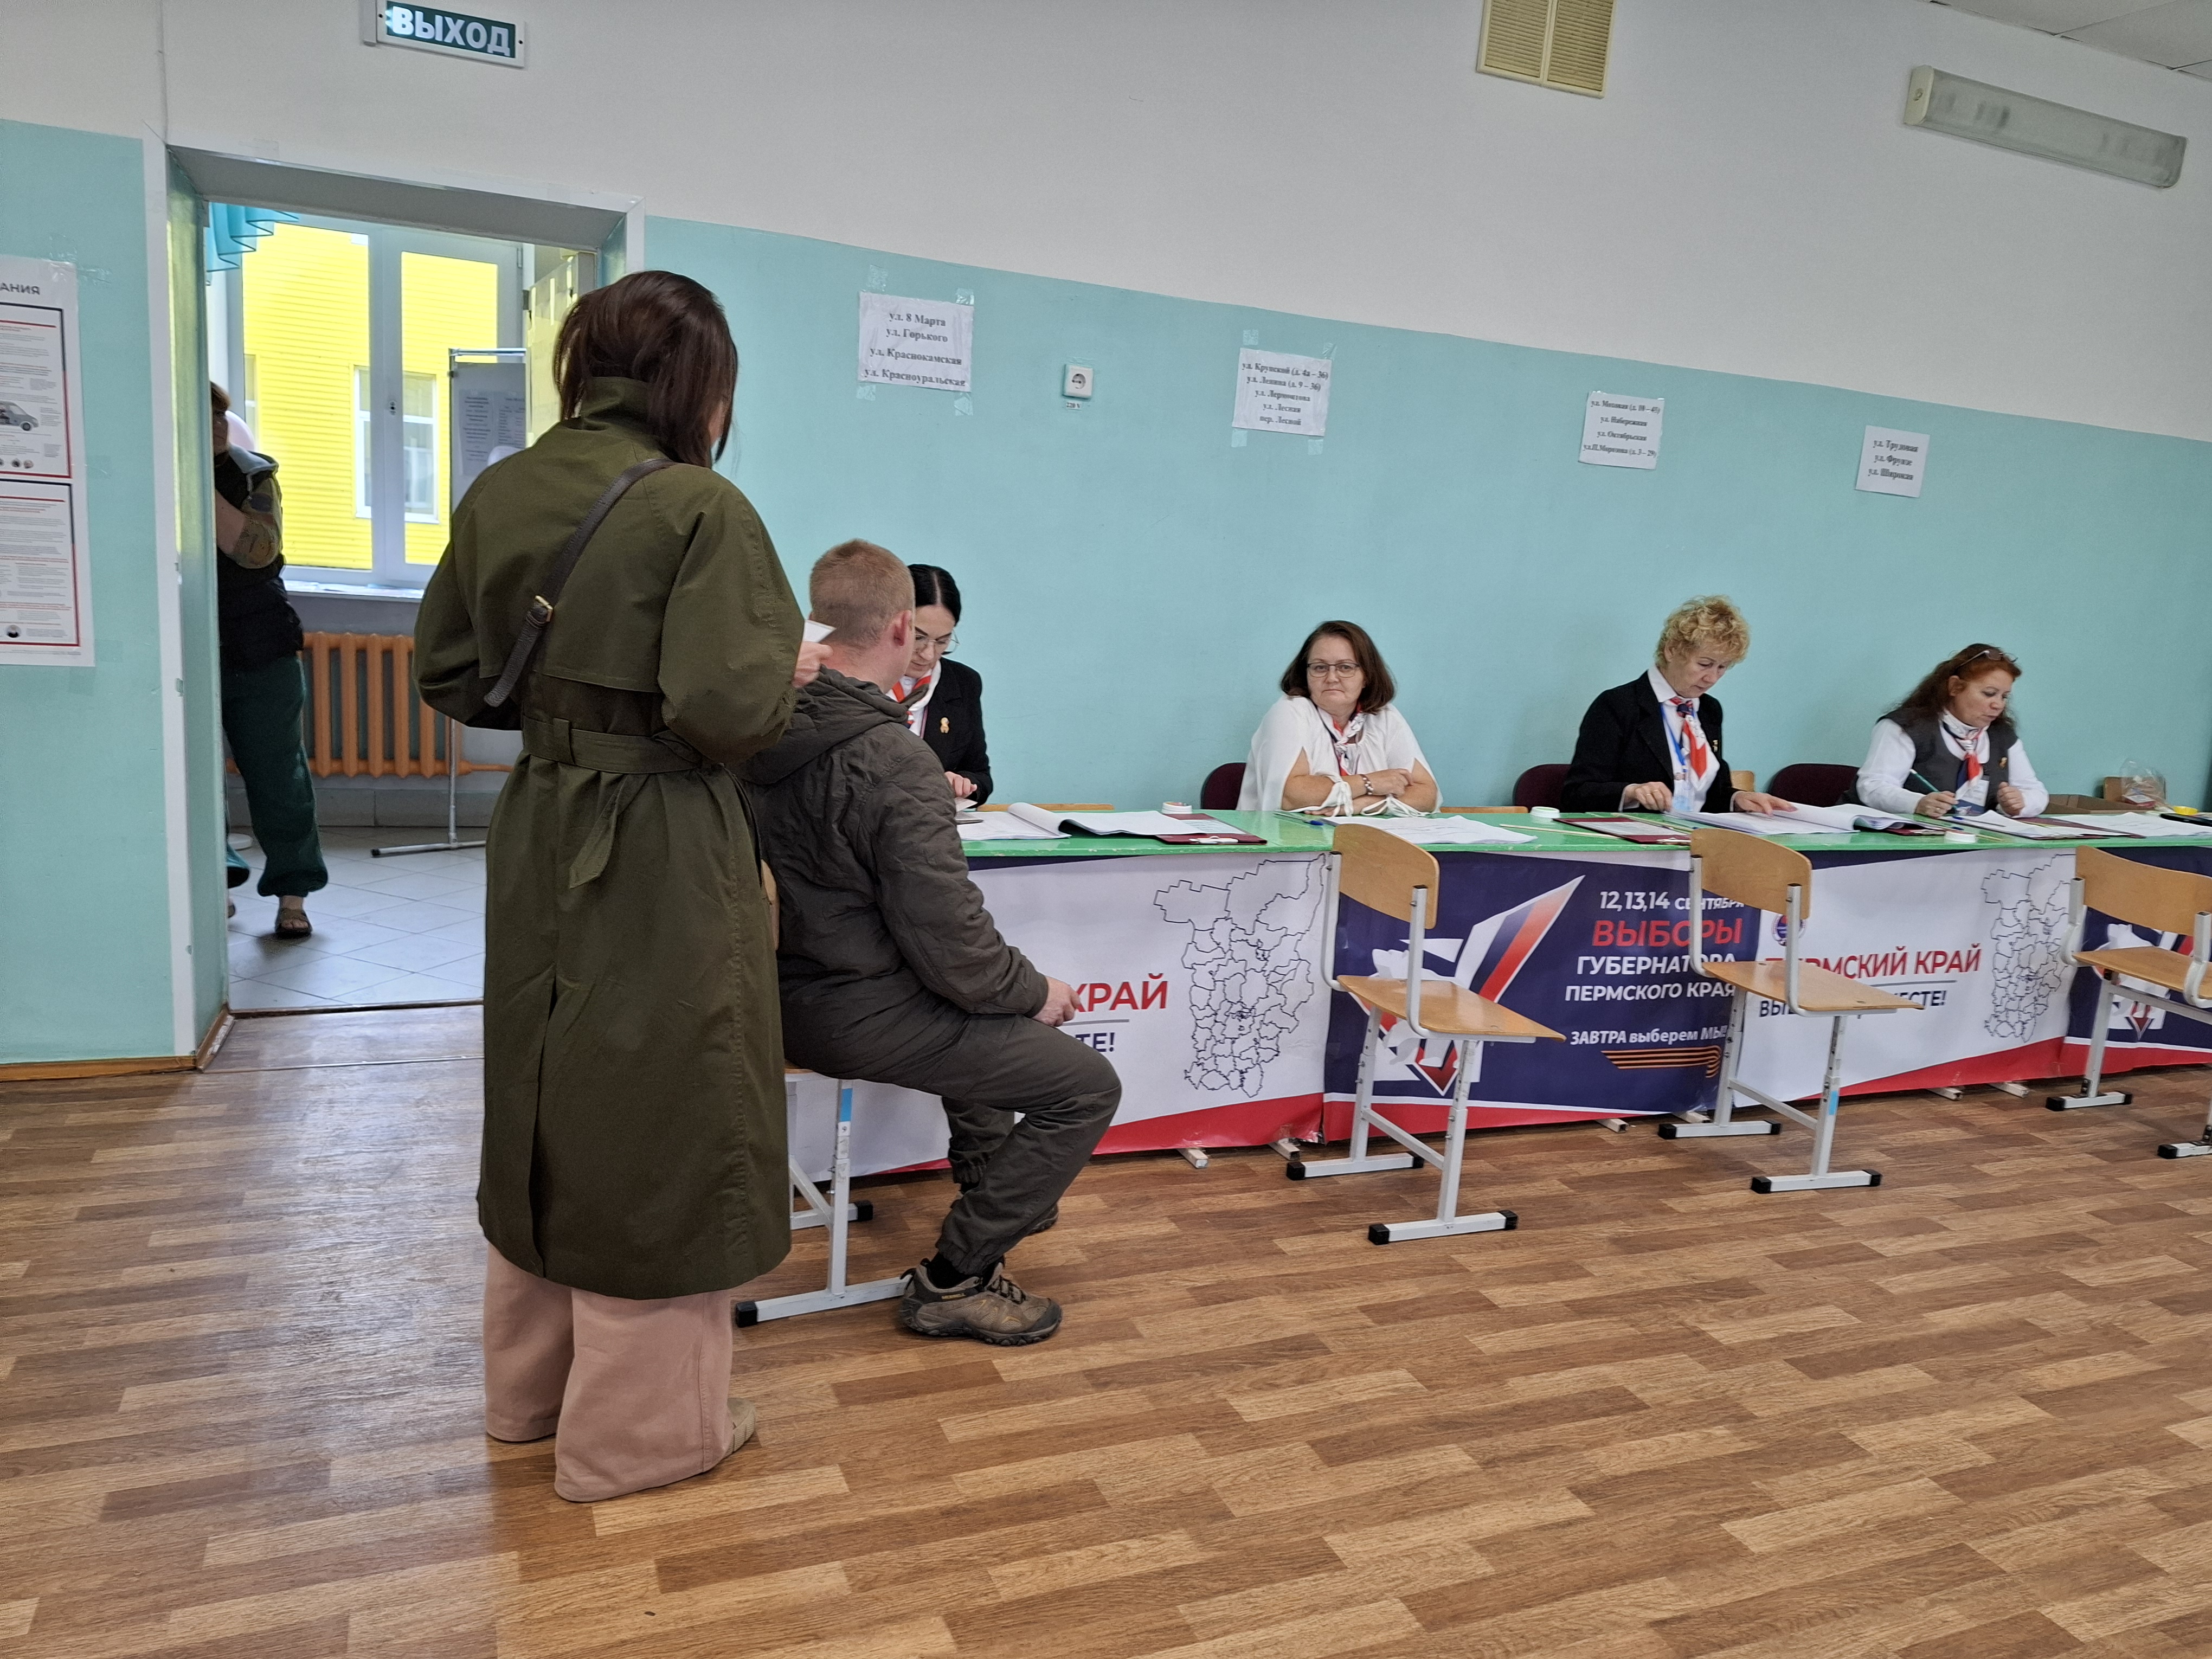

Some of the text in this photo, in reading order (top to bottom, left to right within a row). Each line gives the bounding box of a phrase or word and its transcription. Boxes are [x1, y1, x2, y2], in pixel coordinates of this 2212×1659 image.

[392, 6, 510, 57] ВЫХОД
[889, 313, 946, 327] ул. 8 Марта
[886, 329, 948, 343] ул. Горького
[870, 348, 962, 365] ул. Краснокамская
[865, 369, 966, 387] ул. Красноуральская
[1600, 891, 1670, 912] 12,13,14
[1592, 918, 1742, 947] ВЫБОРЫ
[1914, 942, 1982, 974] КРАЙ
[1565, 982, 1736, 1001] ПЕРМСКОГО КРАЯ
[1570, 1031, 1626, 1045] ЗАВТРА
[1629, 1028, 1698, 1045] выберем
